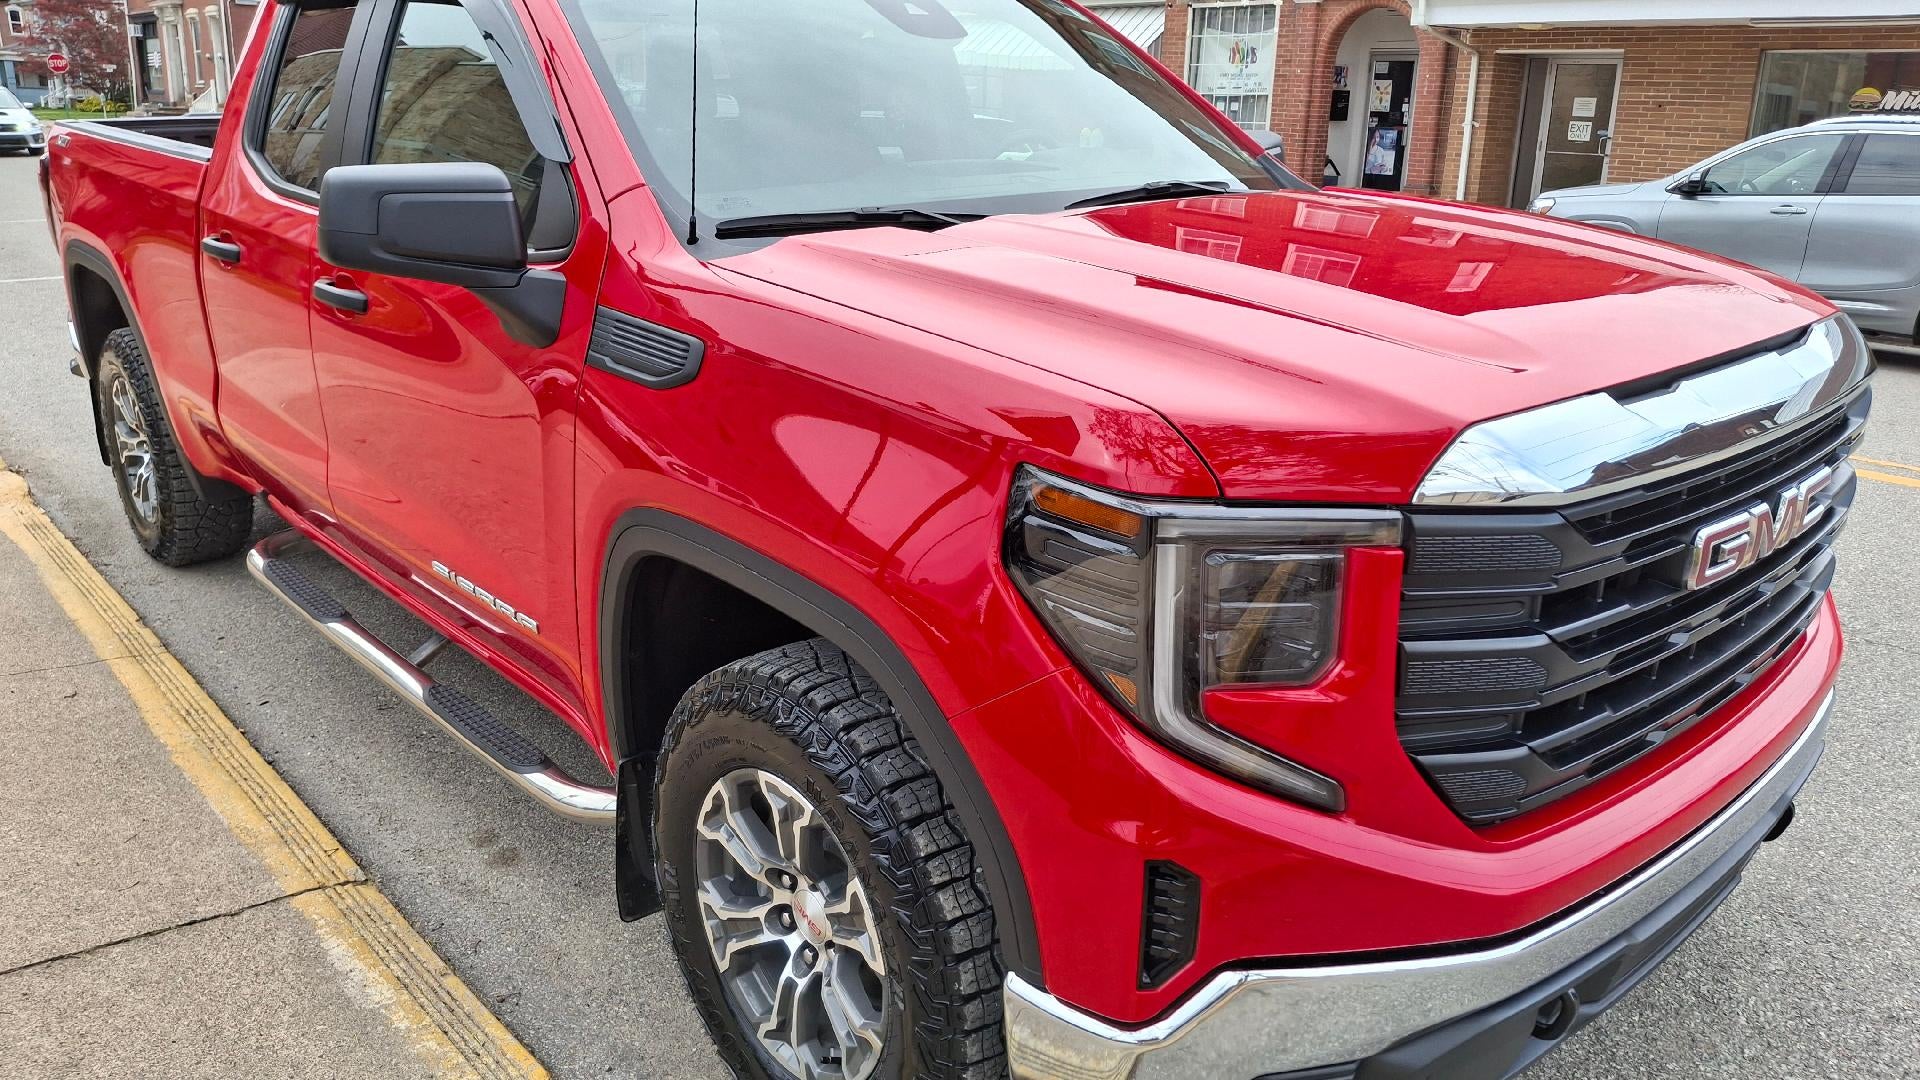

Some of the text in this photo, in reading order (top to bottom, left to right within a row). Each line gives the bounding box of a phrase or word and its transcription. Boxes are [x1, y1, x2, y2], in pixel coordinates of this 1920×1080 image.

[48, 59, 67, 68] STOP
[1569, 123, 1591, 133] EXIT
[1569, 132, 1587, 140] ONLY
[1687, 465, 1833, 591] GMC
[431, 559, 540, 635] SIERRA
[794, 897, 822, 937] GMC
